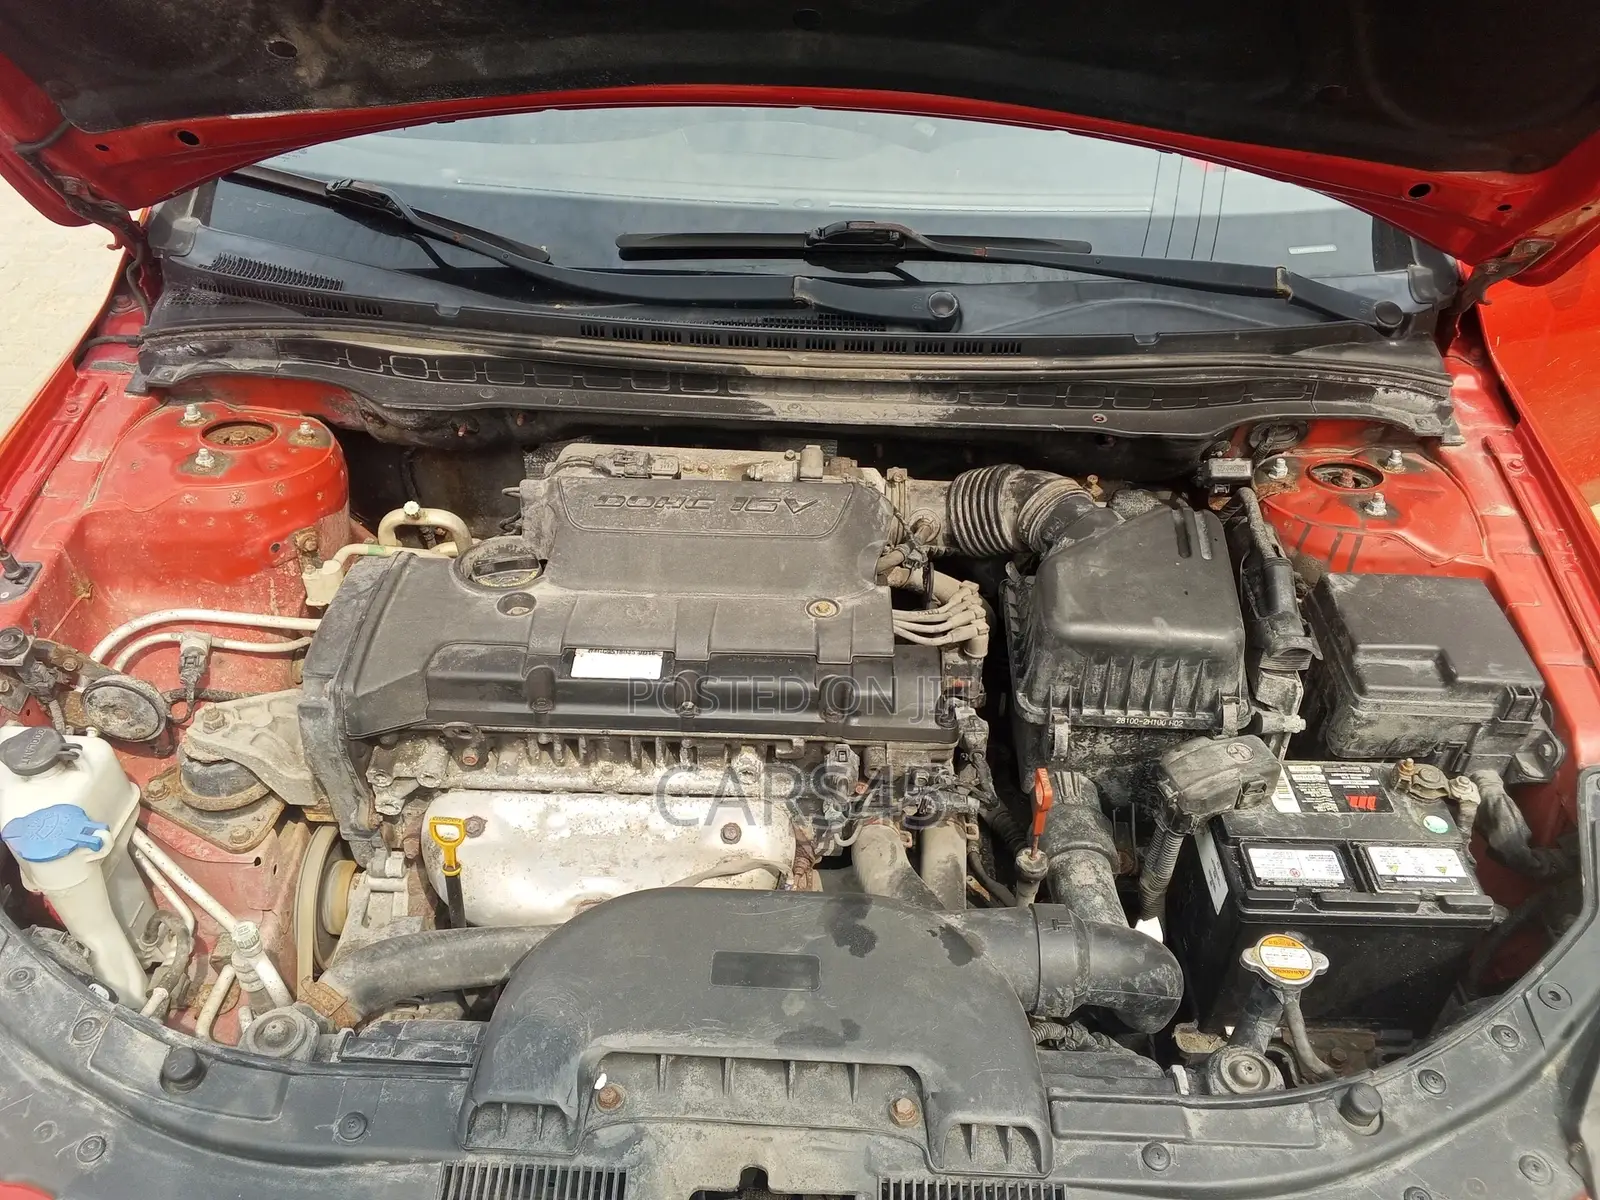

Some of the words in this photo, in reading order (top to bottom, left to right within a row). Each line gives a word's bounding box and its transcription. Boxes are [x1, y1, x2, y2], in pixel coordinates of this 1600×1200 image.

[593, 494, 717, 511] DOHC
[729, 496, 819, 515] 16V
[21, 728, 47, 765] COOLANT
